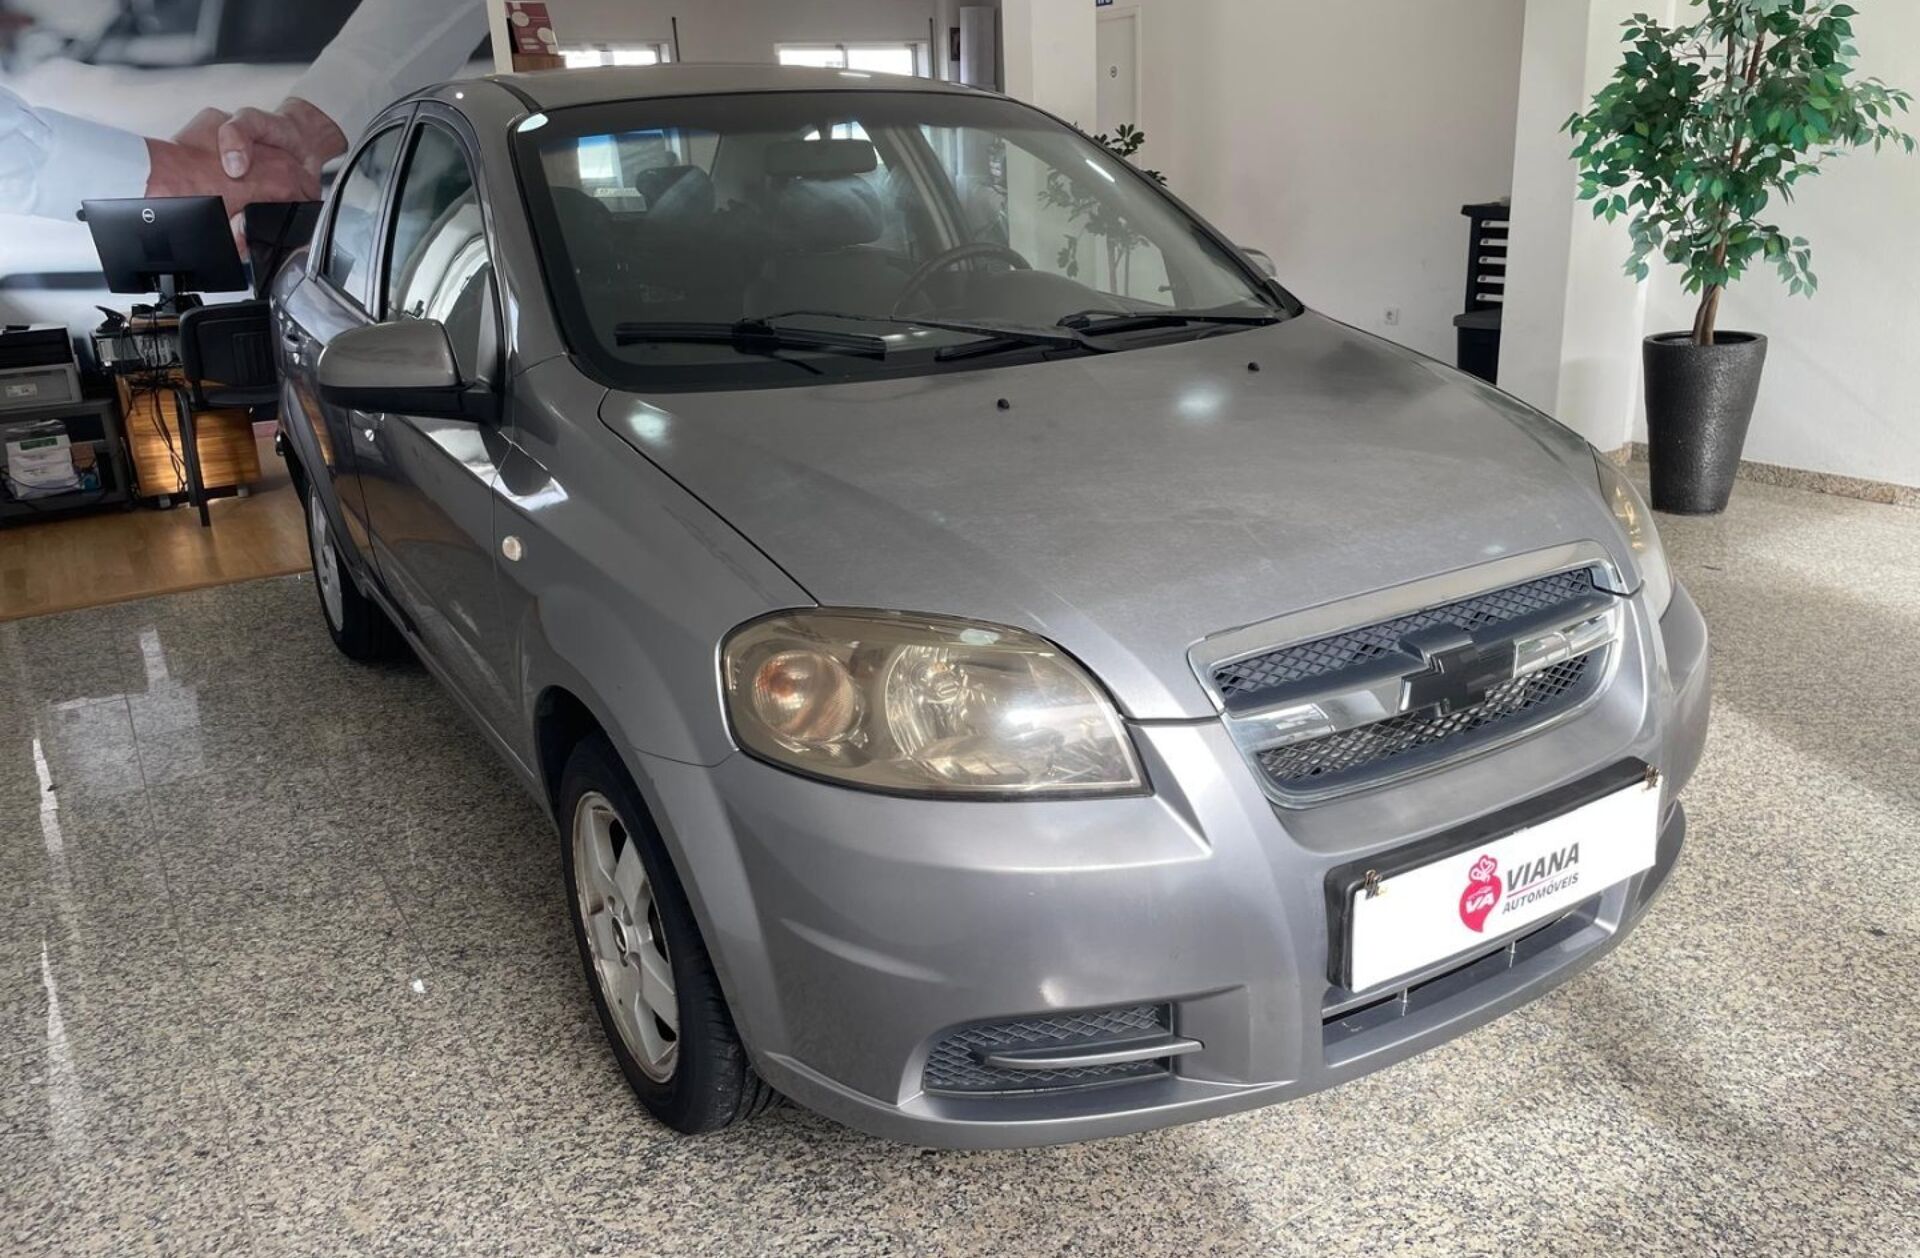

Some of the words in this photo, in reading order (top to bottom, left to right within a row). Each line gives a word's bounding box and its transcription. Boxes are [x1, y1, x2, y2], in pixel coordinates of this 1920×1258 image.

[1506, 842, 1579, 892] VIANA
[1465, 892, 1495, 914] VA
[1502, 872, 1579, 914] AUTOMÓVEIS
